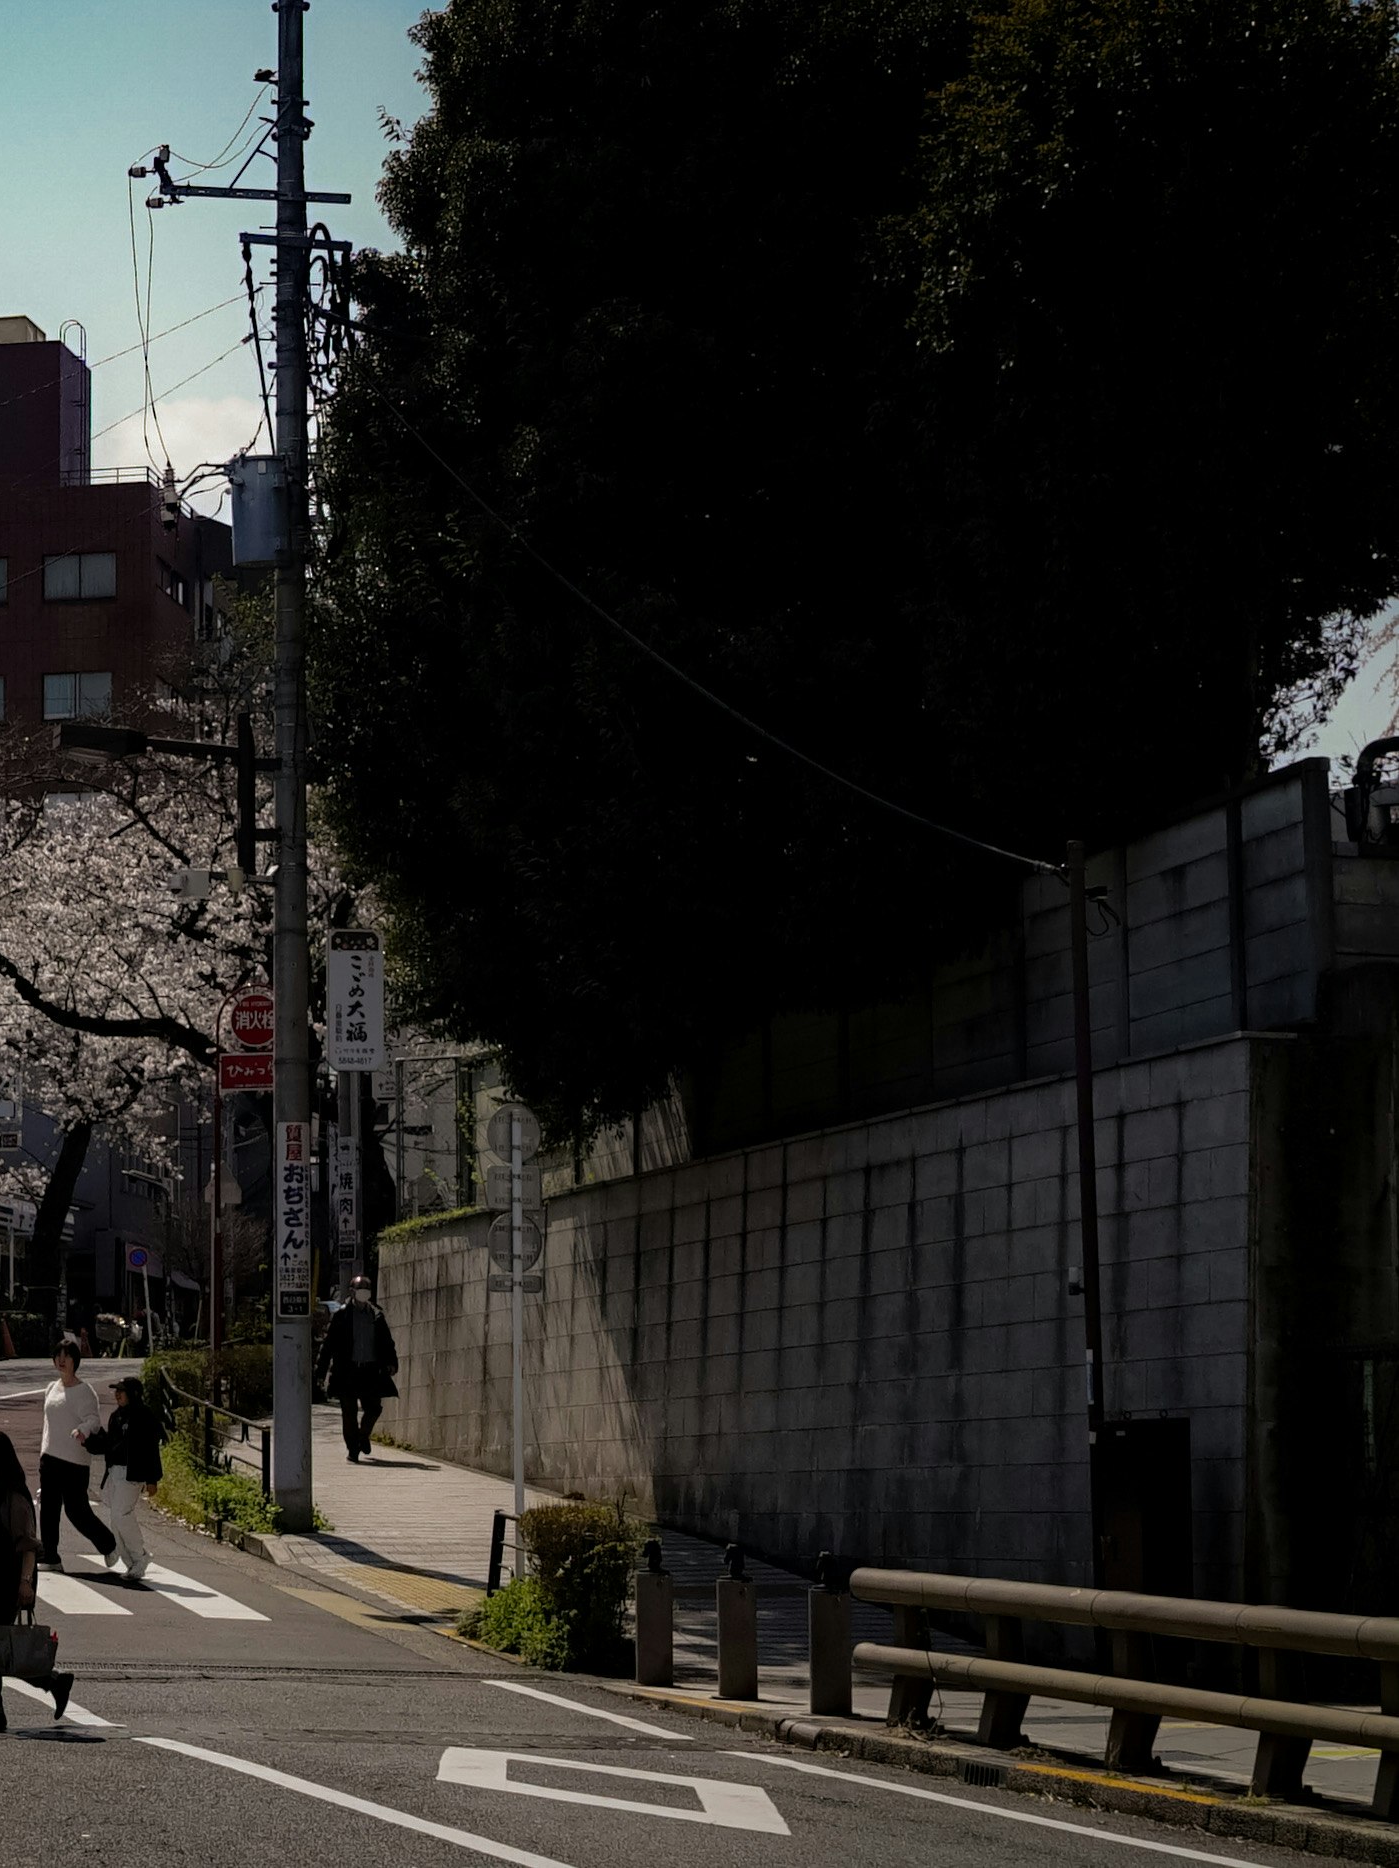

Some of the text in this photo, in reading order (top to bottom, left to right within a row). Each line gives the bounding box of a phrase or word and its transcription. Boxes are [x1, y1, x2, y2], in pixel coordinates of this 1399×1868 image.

[226, 1061, 274, 1079] ひみつ
[286, 1124, 302, 1161] 質屋
[339, 1172, 354, 1215] 焼肉
